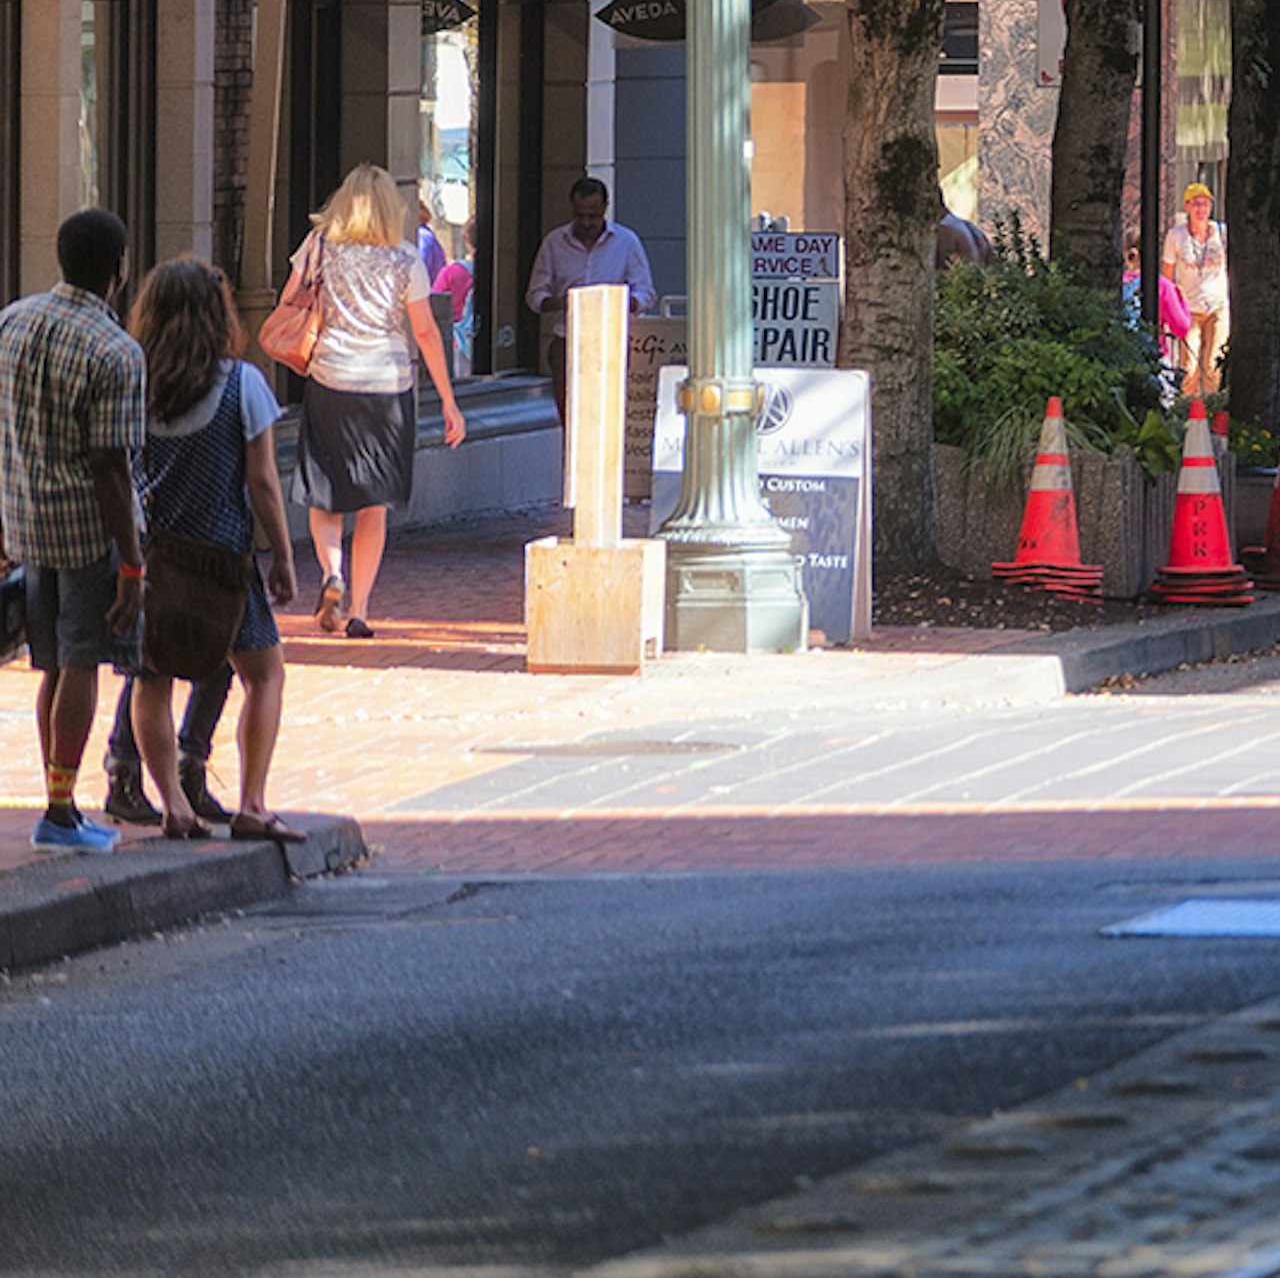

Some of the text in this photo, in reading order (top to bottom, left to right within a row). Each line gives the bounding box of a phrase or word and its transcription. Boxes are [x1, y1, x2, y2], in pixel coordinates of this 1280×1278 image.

[610, 0, 677, 25] AVEDA
[796, 238, 832, 253] DAY
[767, 478, 825, 492] CUSTOM
[809, 553, 847, 569] TASTE
